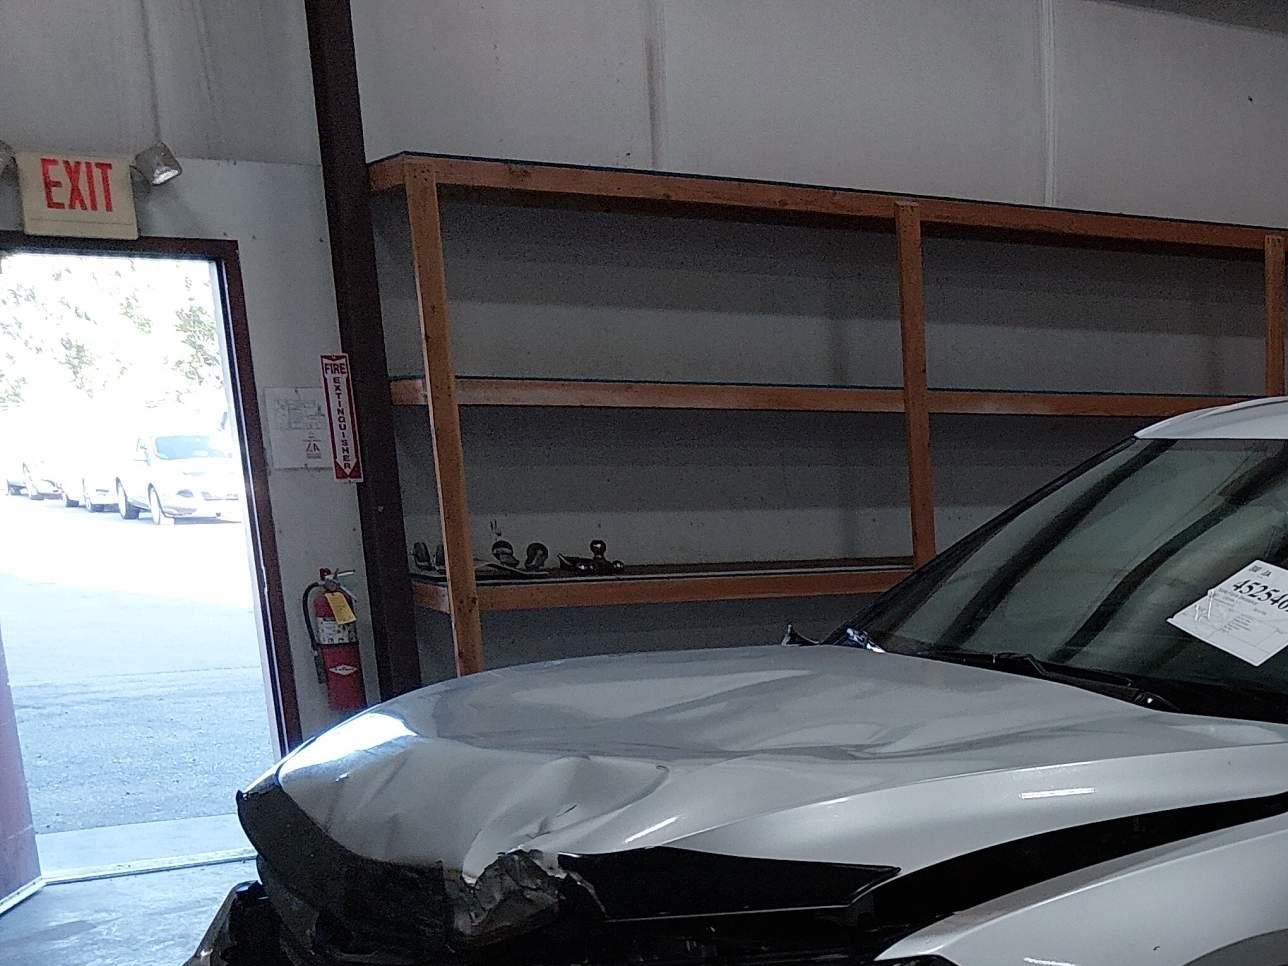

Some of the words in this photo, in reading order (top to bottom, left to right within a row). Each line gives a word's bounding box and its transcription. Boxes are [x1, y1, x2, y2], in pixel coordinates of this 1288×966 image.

[40, 158, 113, 212] EXIT
[324, 363, 347, 375] FIRE
[333, 377, 351, 469] EXTINGUISHER
